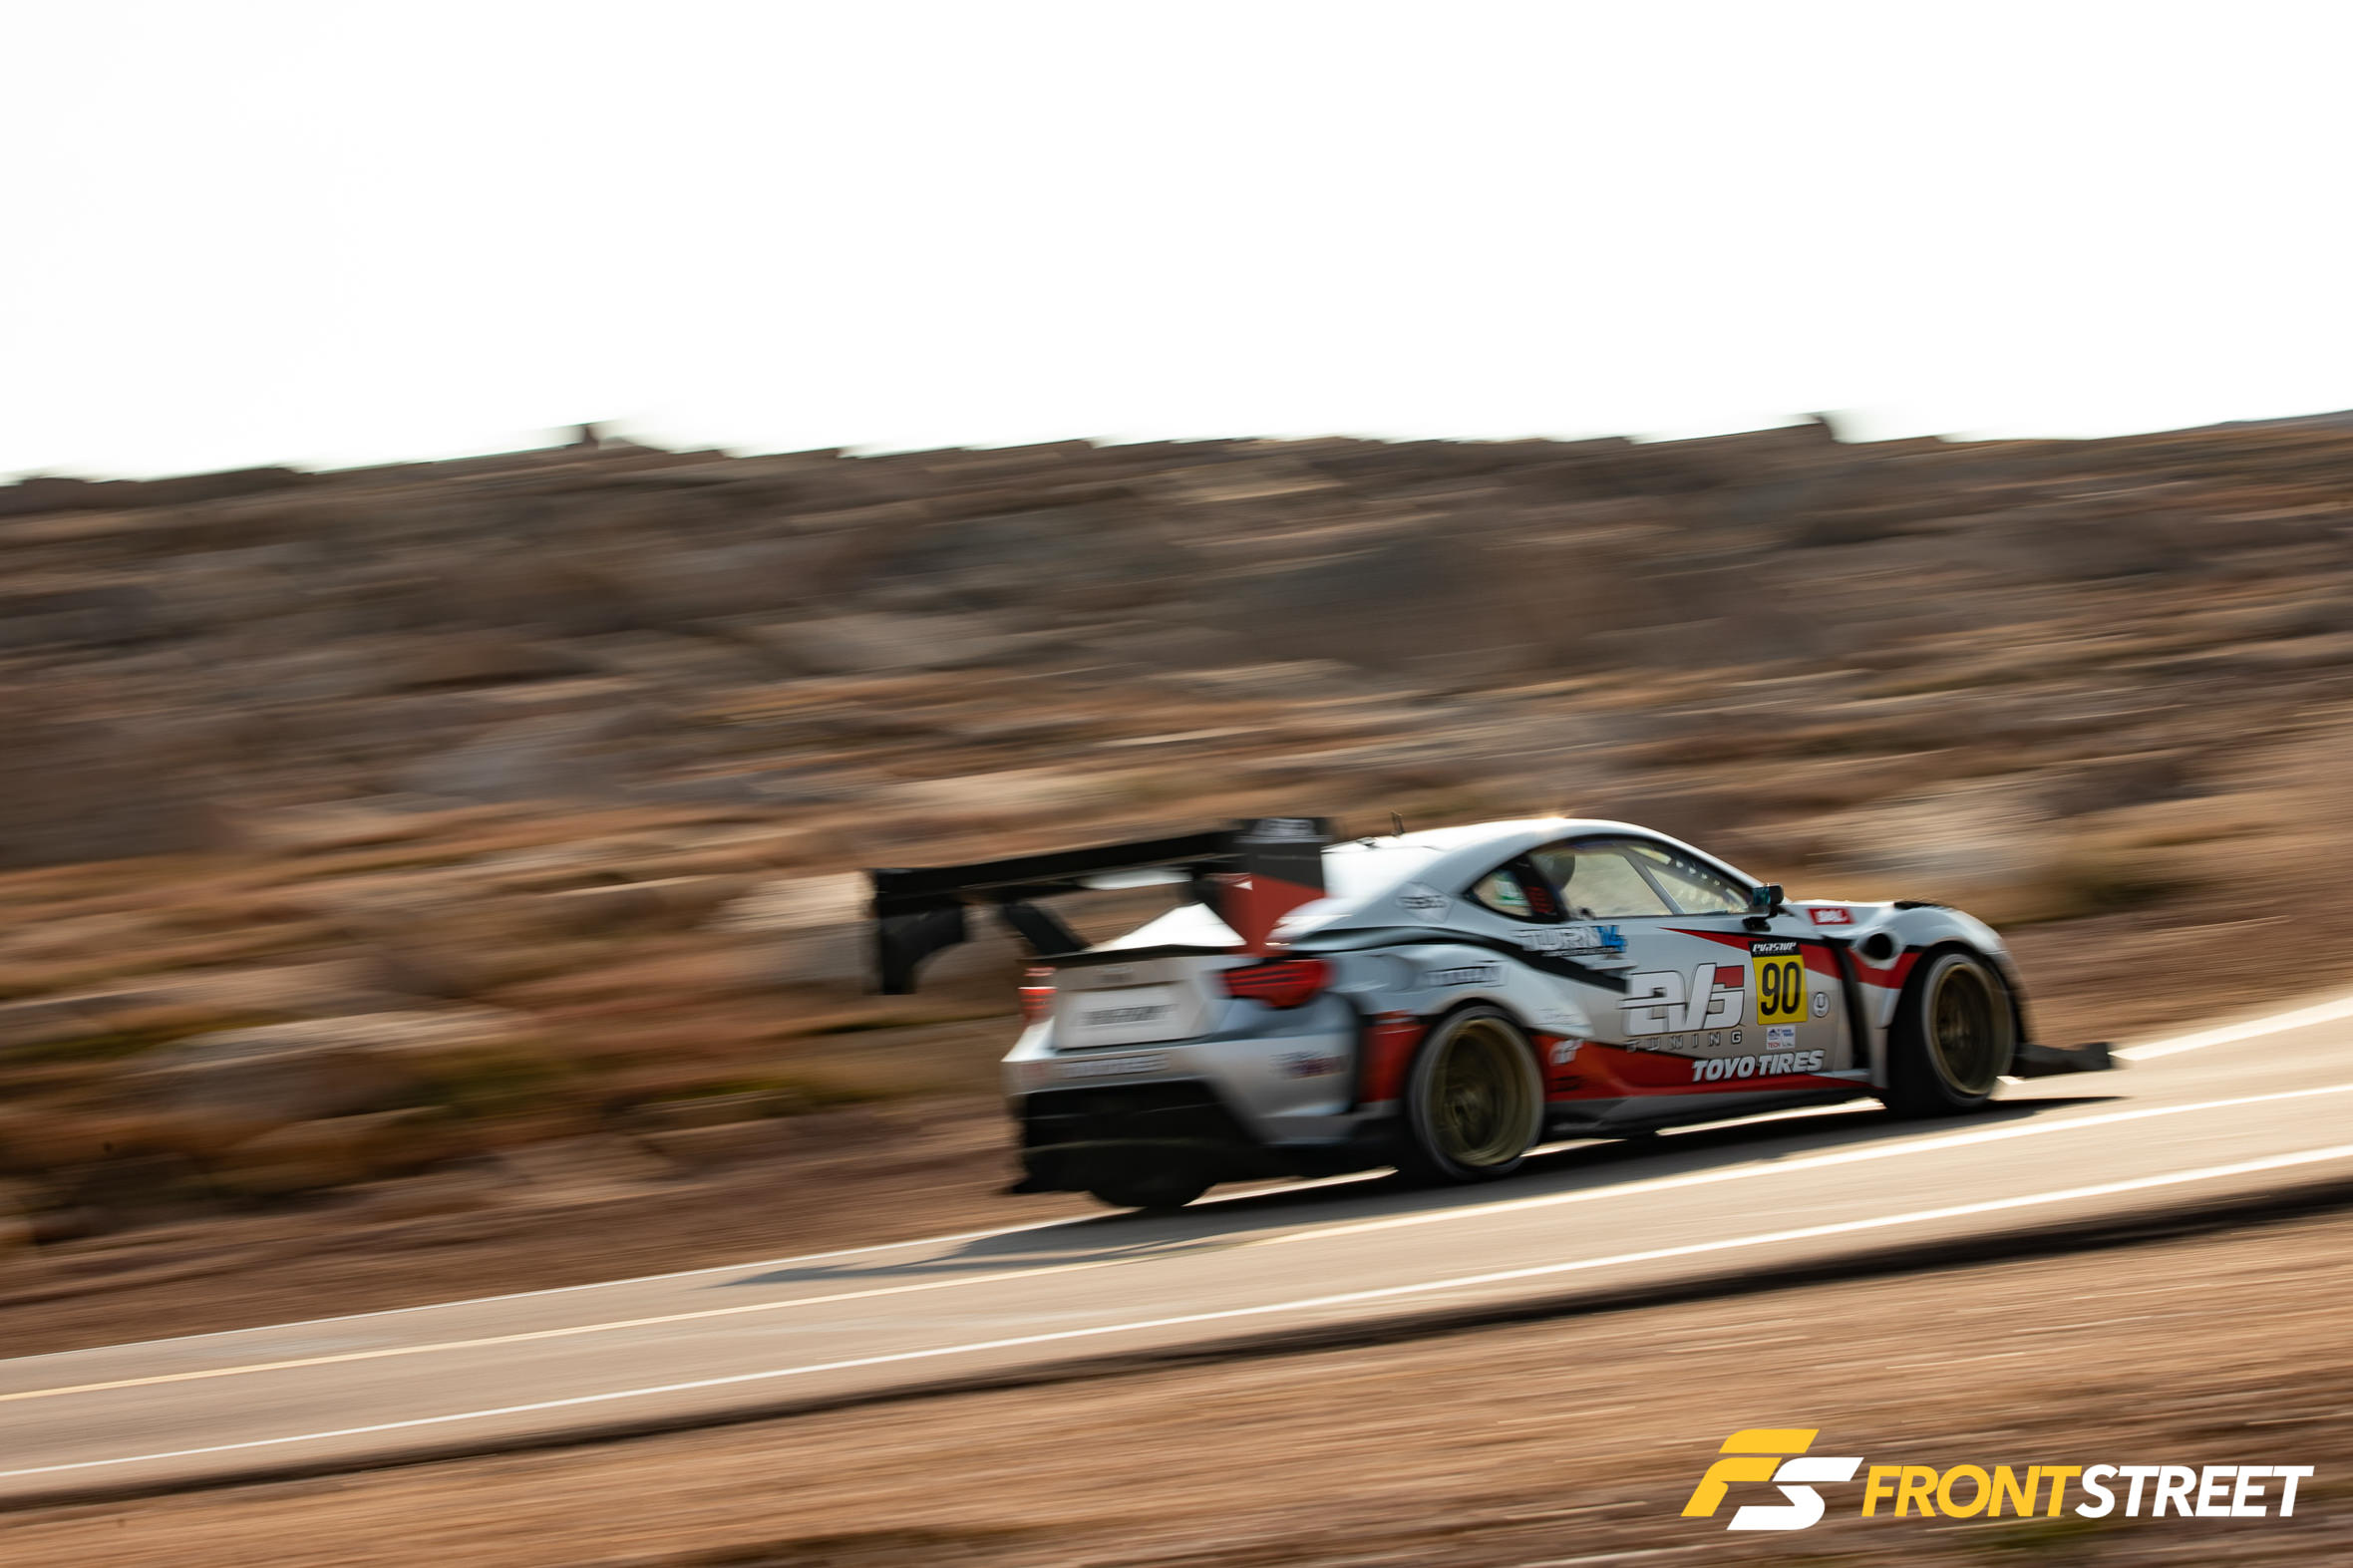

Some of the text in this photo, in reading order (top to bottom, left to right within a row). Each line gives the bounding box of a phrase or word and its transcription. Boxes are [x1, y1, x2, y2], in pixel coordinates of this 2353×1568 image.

[1761, 961, 1802, 1016] 90
[1692, 1050, 1826, 1083] TOYO TIRES
